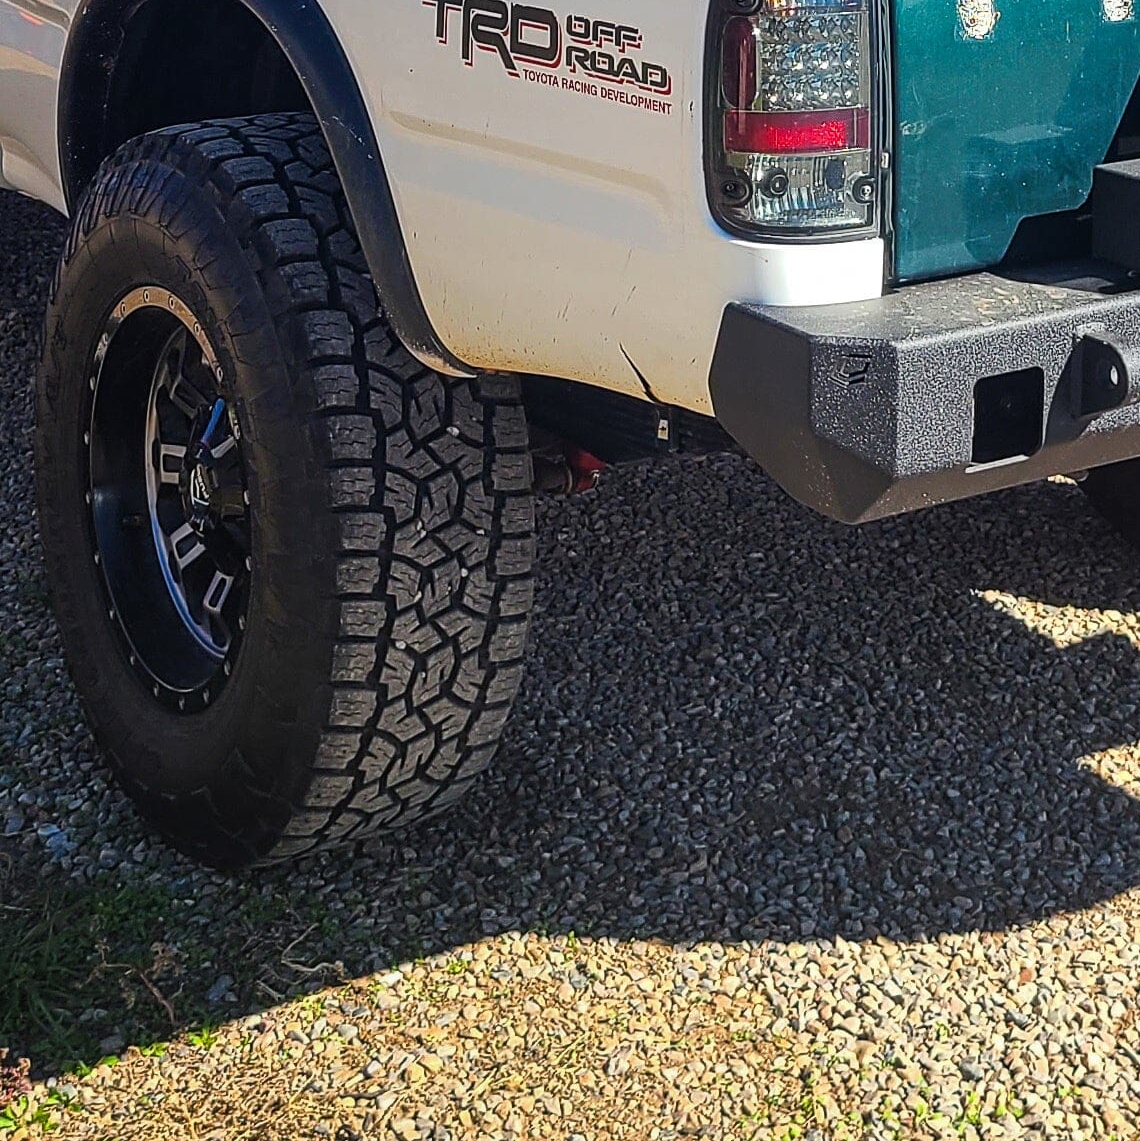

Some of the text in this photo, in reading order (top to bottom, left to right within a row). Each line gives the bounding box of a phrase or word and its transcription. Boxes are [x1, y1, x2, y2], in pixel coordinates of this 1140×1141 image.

[566, 14, 643, 53] OFF
[522, 68, 673, 116] TOYOTA RACING DEVELOPMENT
[565, 46, 672, 96] ROAD
